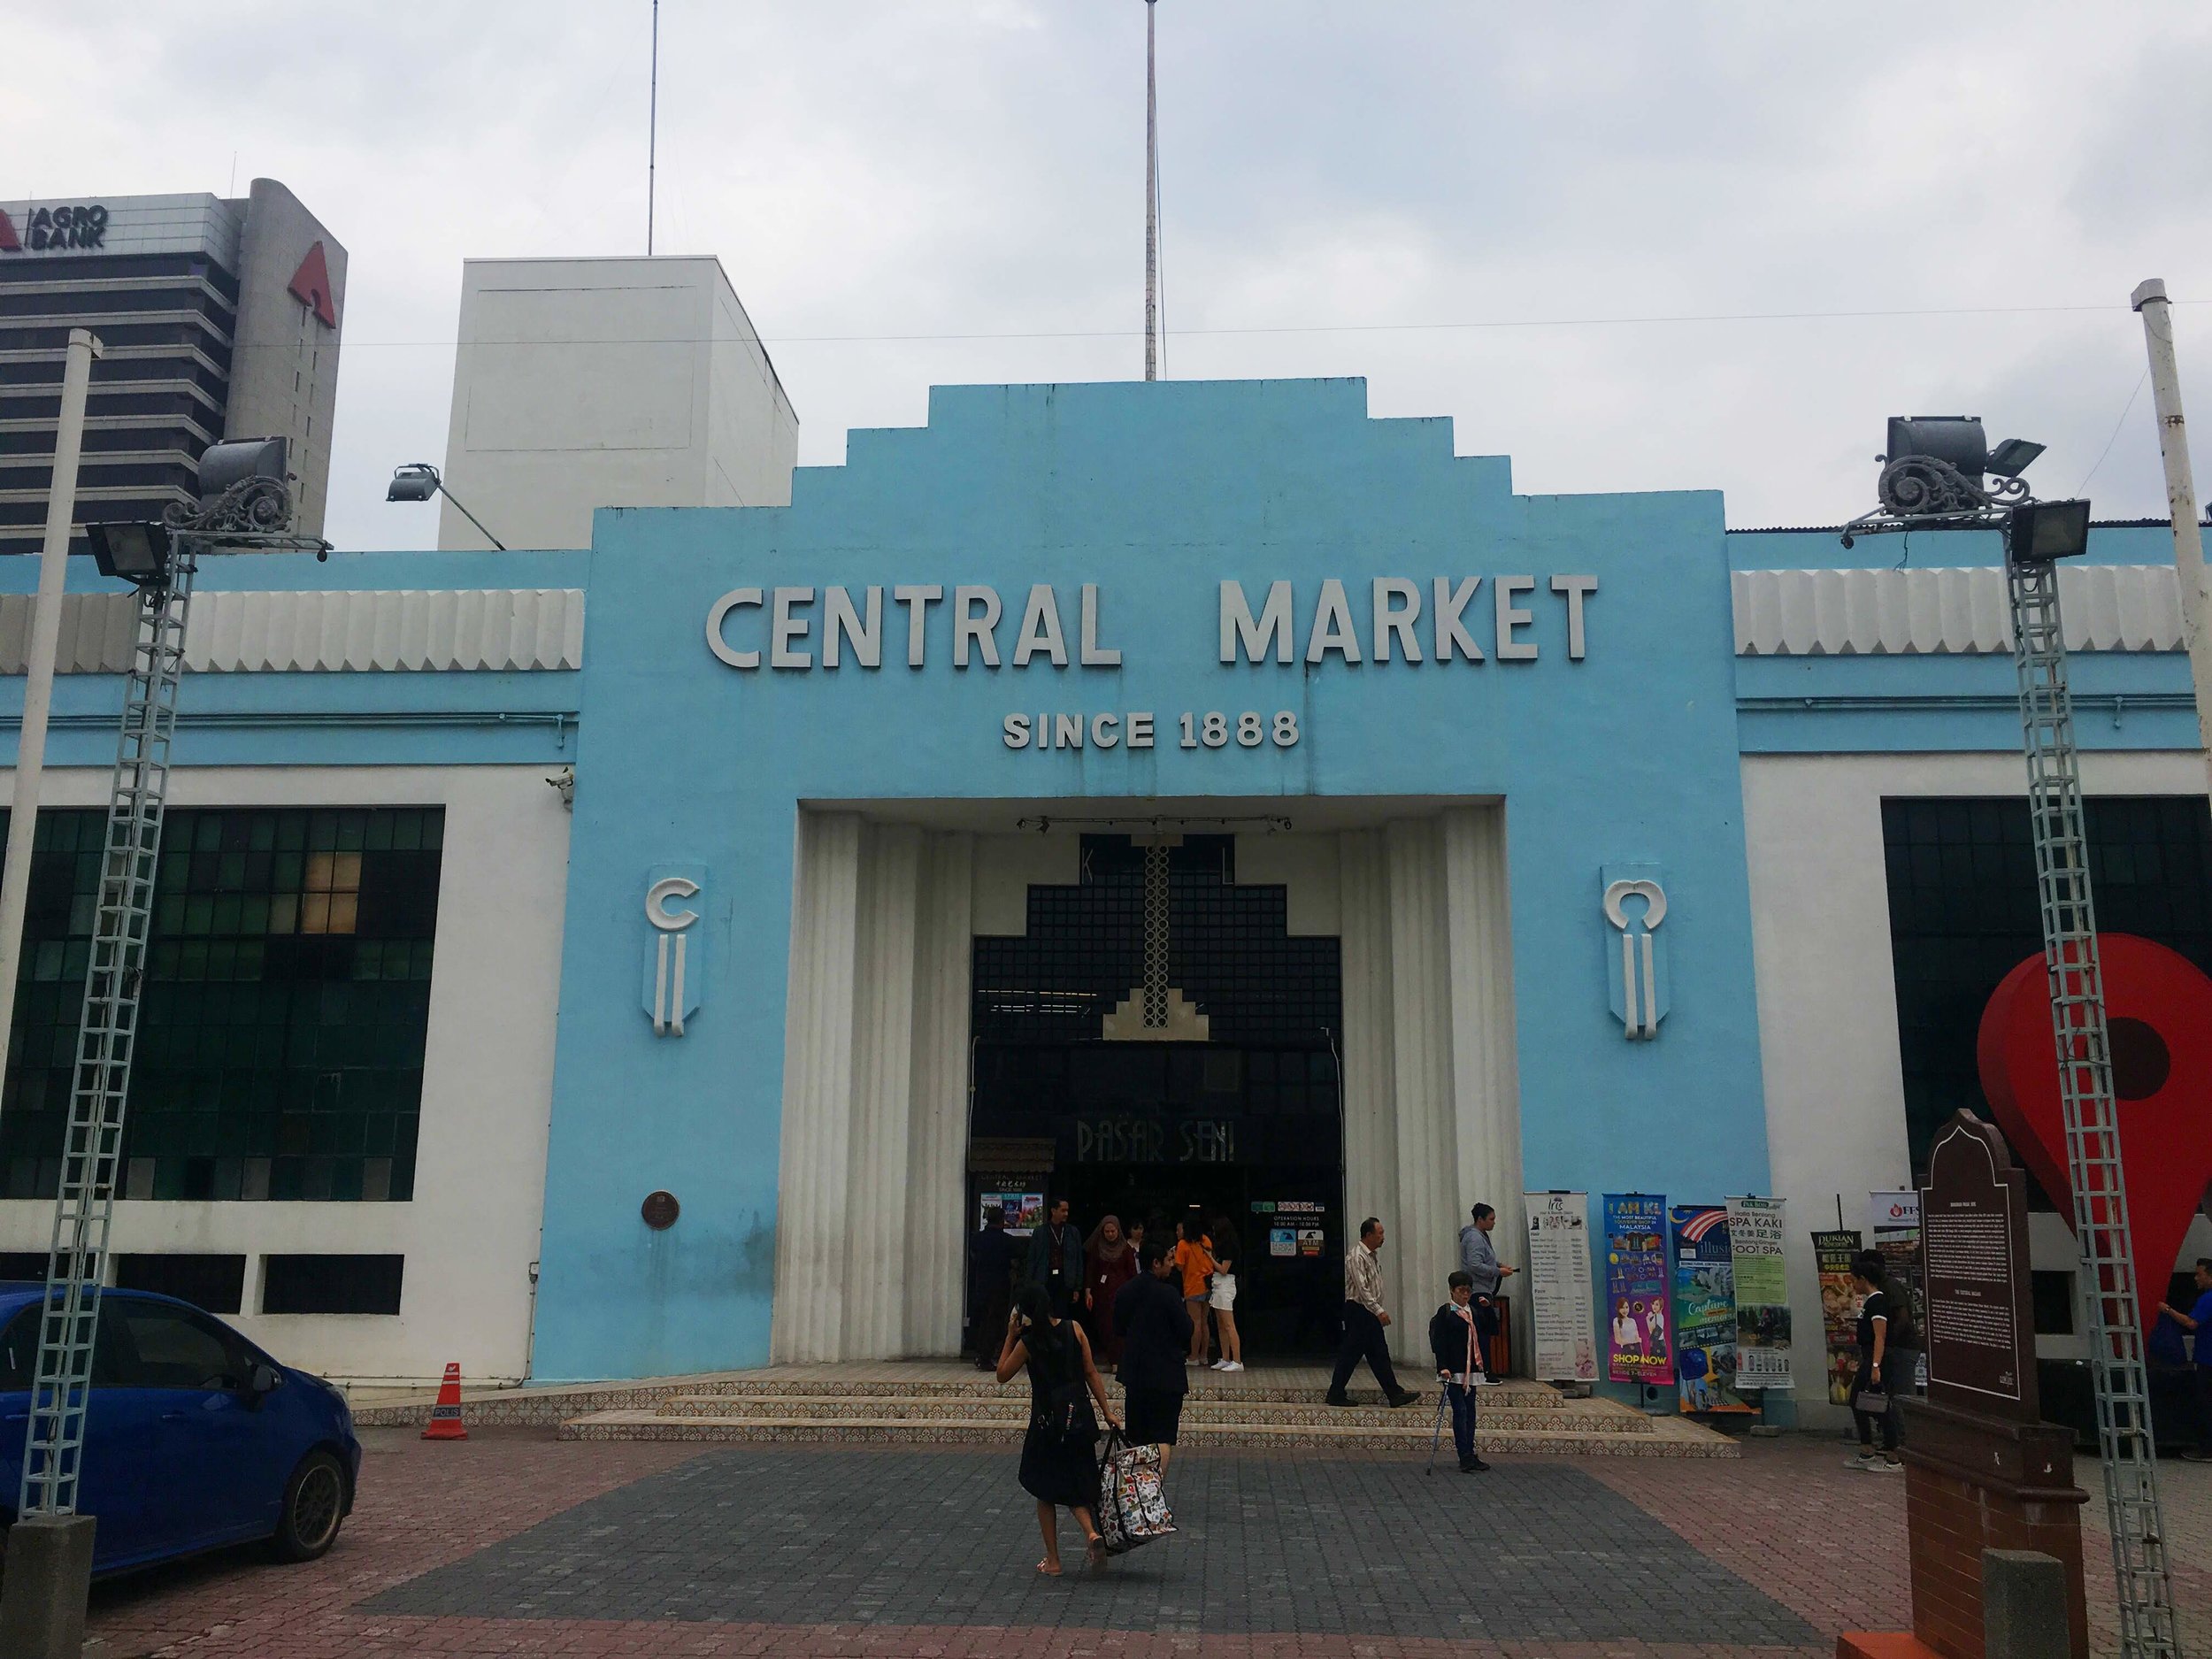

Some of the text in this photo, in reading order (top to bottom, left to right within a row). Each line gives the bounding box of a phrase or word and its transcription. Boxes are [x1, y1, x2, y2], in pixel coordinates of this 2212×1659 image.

[32, 204, 108, 229] AGRO
[31, 226, 104, 250] BANK
[705, 574, 1598, 669] CENTRAL MARKET
[1002, 710, 1300, 748] SINCE 1888
[1077, 1119, 1235, 1162] PASAR SENI
[1548, 1198, 1563, 1211] Iris
[1608, 1201, 1662, 1215] I AM KL
[1729, 1217, 1782, 1228] SPA KAKI
[1818, 1234, 1855, 1247] DURIAN
[1763, 1246, 1784, 1255] SPA
[1688, 1299, 1729, 1316] Capture
[1613, 1354, 1667, 1365] SHOP NOW
